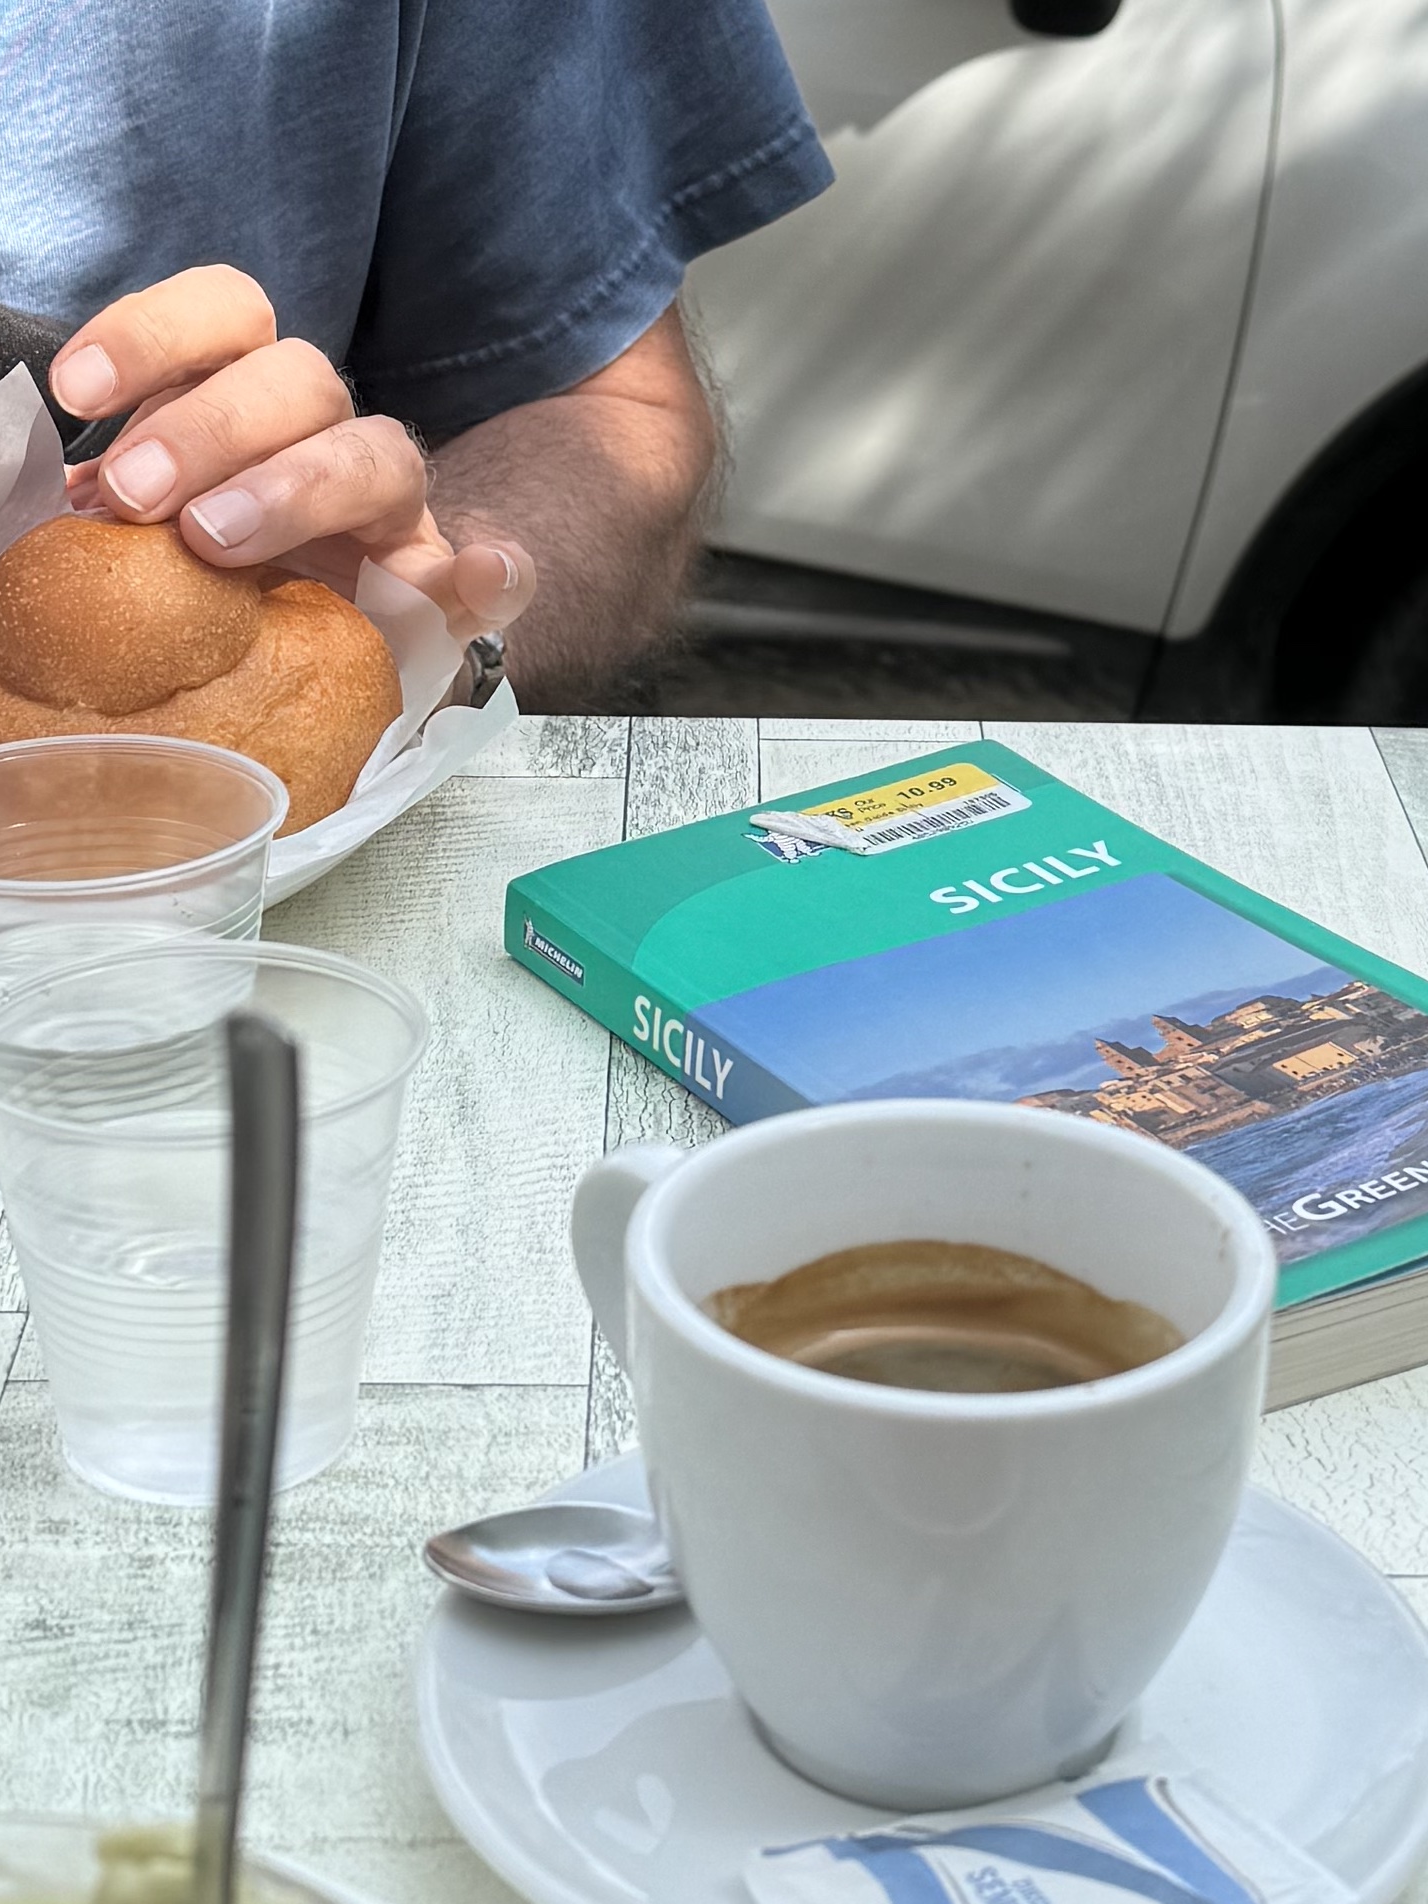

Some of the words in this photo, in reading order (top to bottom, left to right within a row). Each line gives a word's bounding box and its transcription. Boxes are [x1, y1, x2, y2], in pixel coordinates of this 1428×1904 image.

[896, 776, 958, 800] 10.99
[929, 840, 1122, 914] SICILY
[534, 935, 584, 980] MICHELIN
[633, 995, 734, 1101] SICILY
